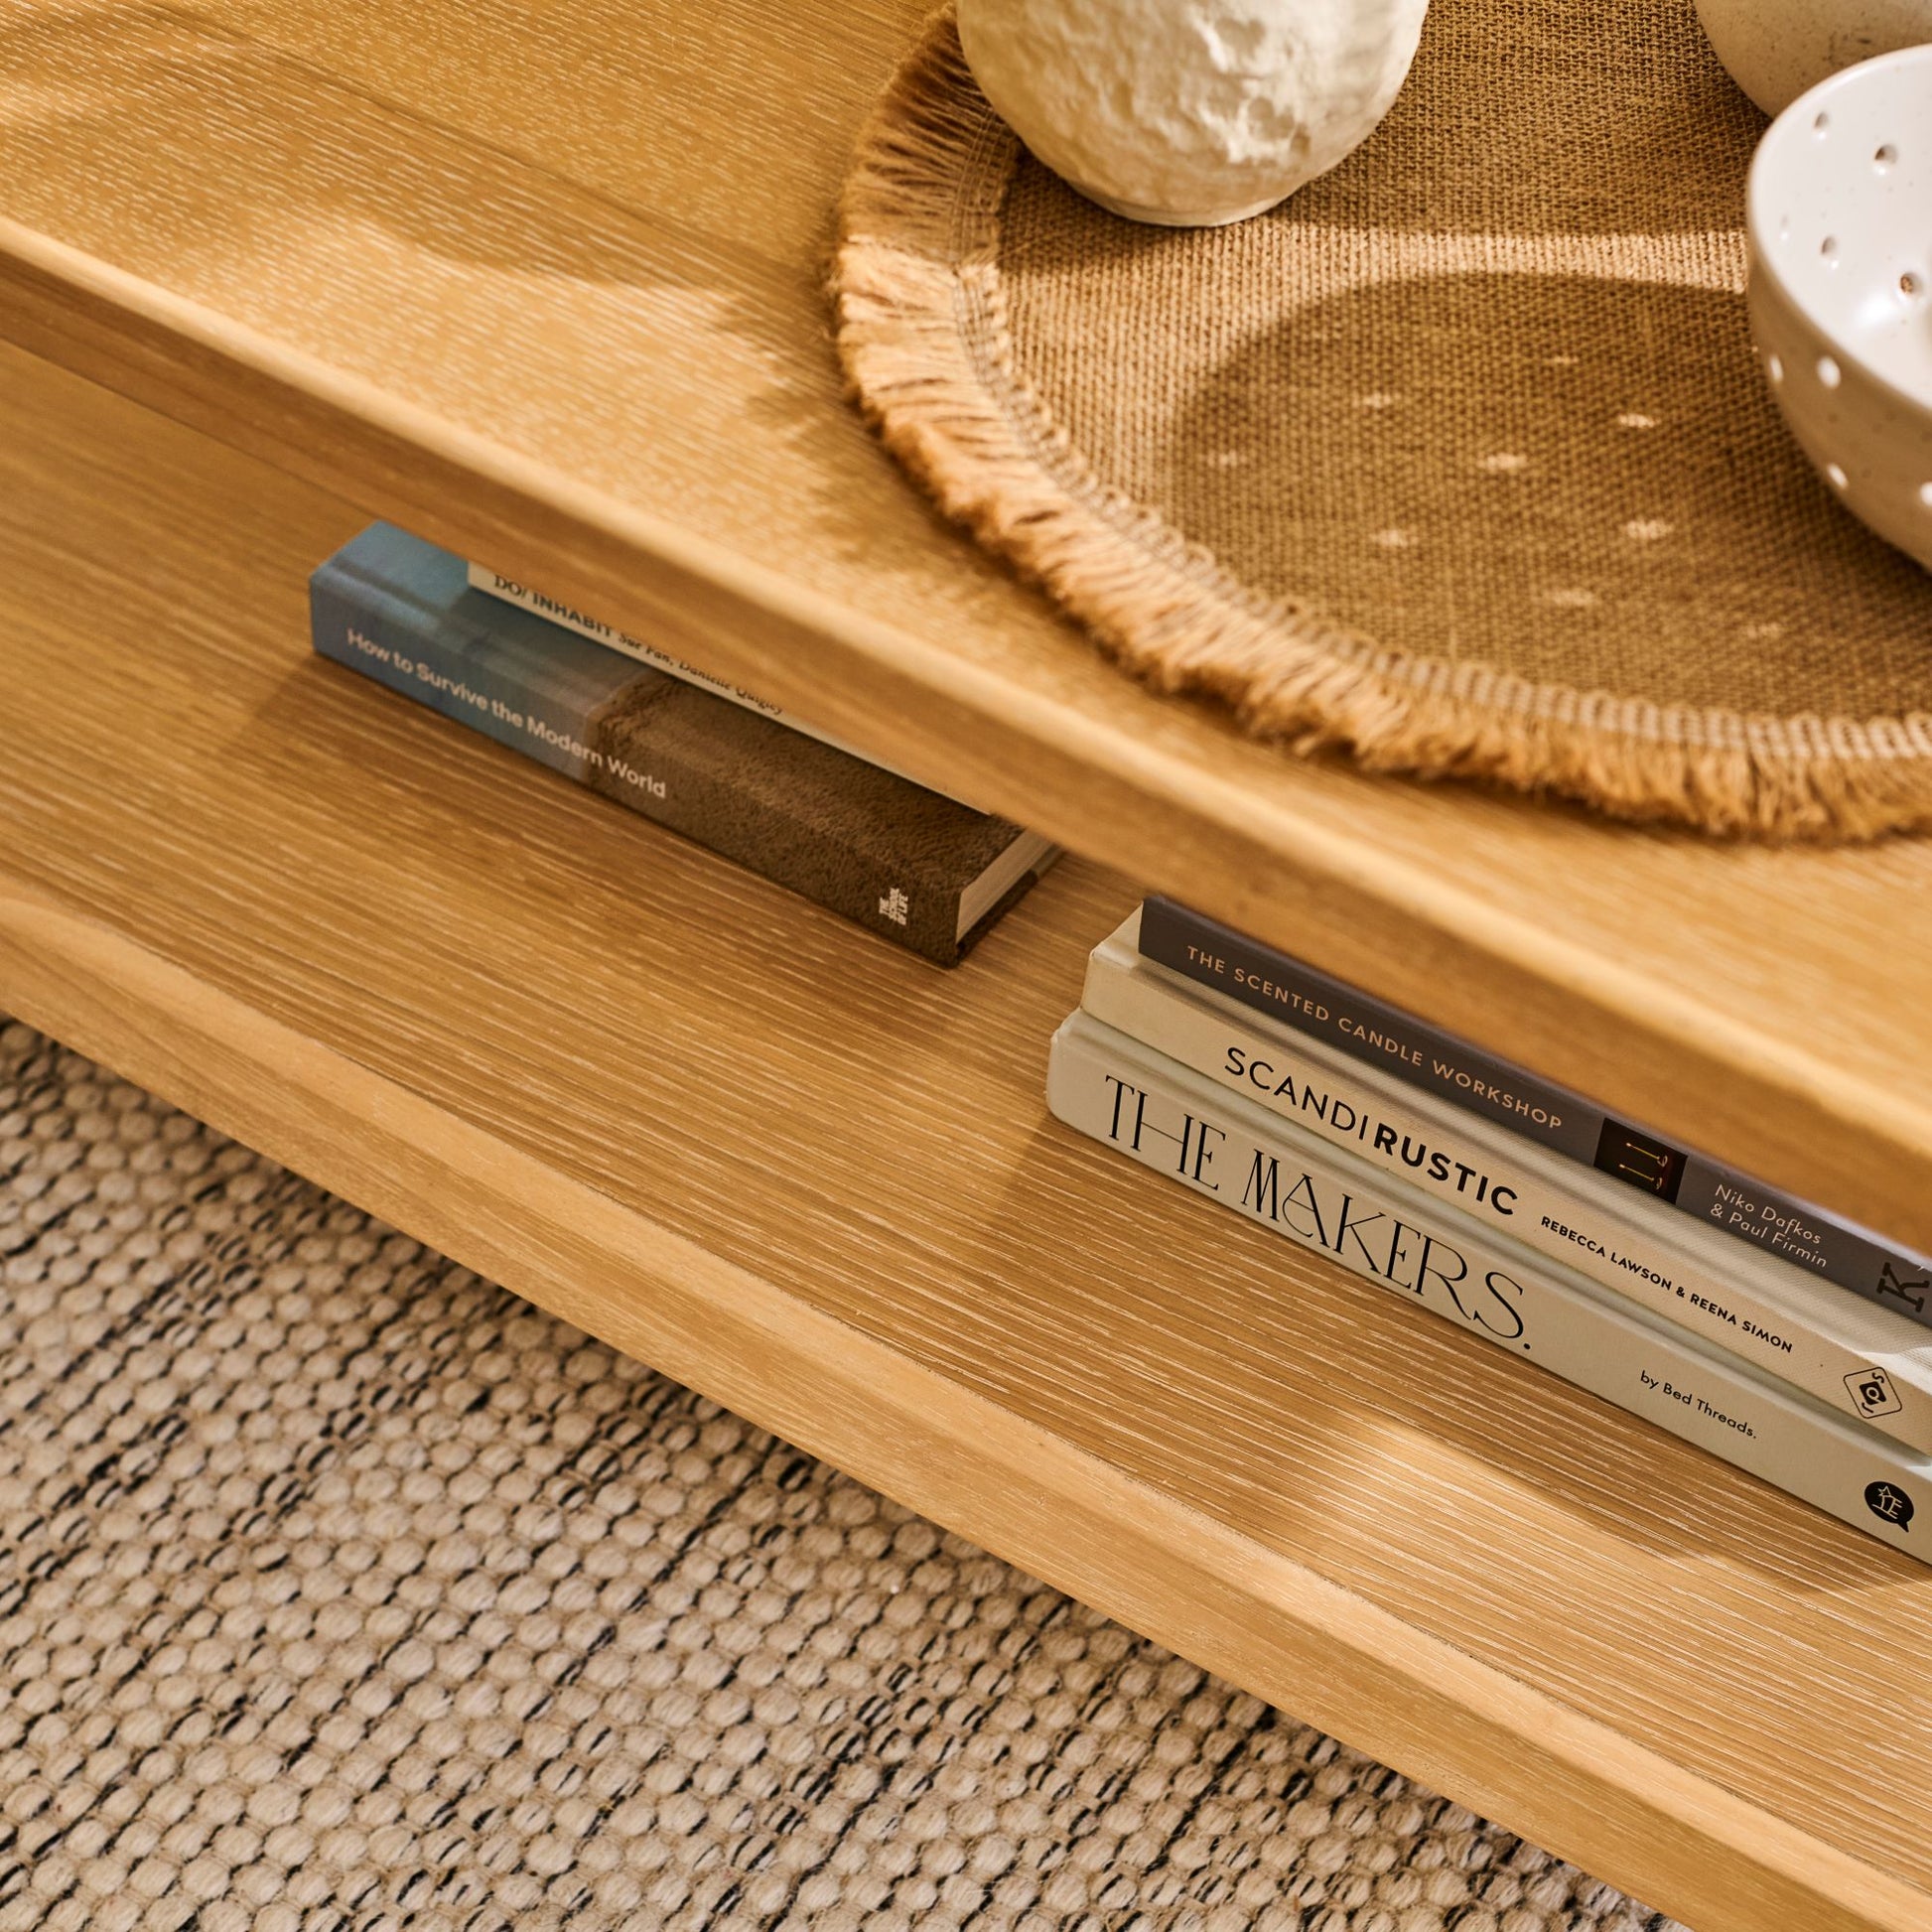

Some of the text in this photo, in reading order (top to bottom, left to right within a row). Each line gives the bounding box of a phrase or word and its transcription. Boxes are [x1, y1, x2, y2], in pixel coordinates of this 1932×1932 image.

[533, 593, 613, 637] INHABIT
[347, 626, 666, 798] How to Survive the Modern World
[1187, 944, 1563, 1129] THE SCENTED CANDLE WORKSHOP
[1105, 1074, 1227, 1191] THE
[1710, 1202, 1827, 1268] & Paul Firmin
[1715, 1183, 1822, 1245] Niko Dafkos
[1541, 1215, 1793, 1353] REBECCA LAWSON & REENA SIMON
[1640, 1369, 1757, 1440] by Bed Threads.
